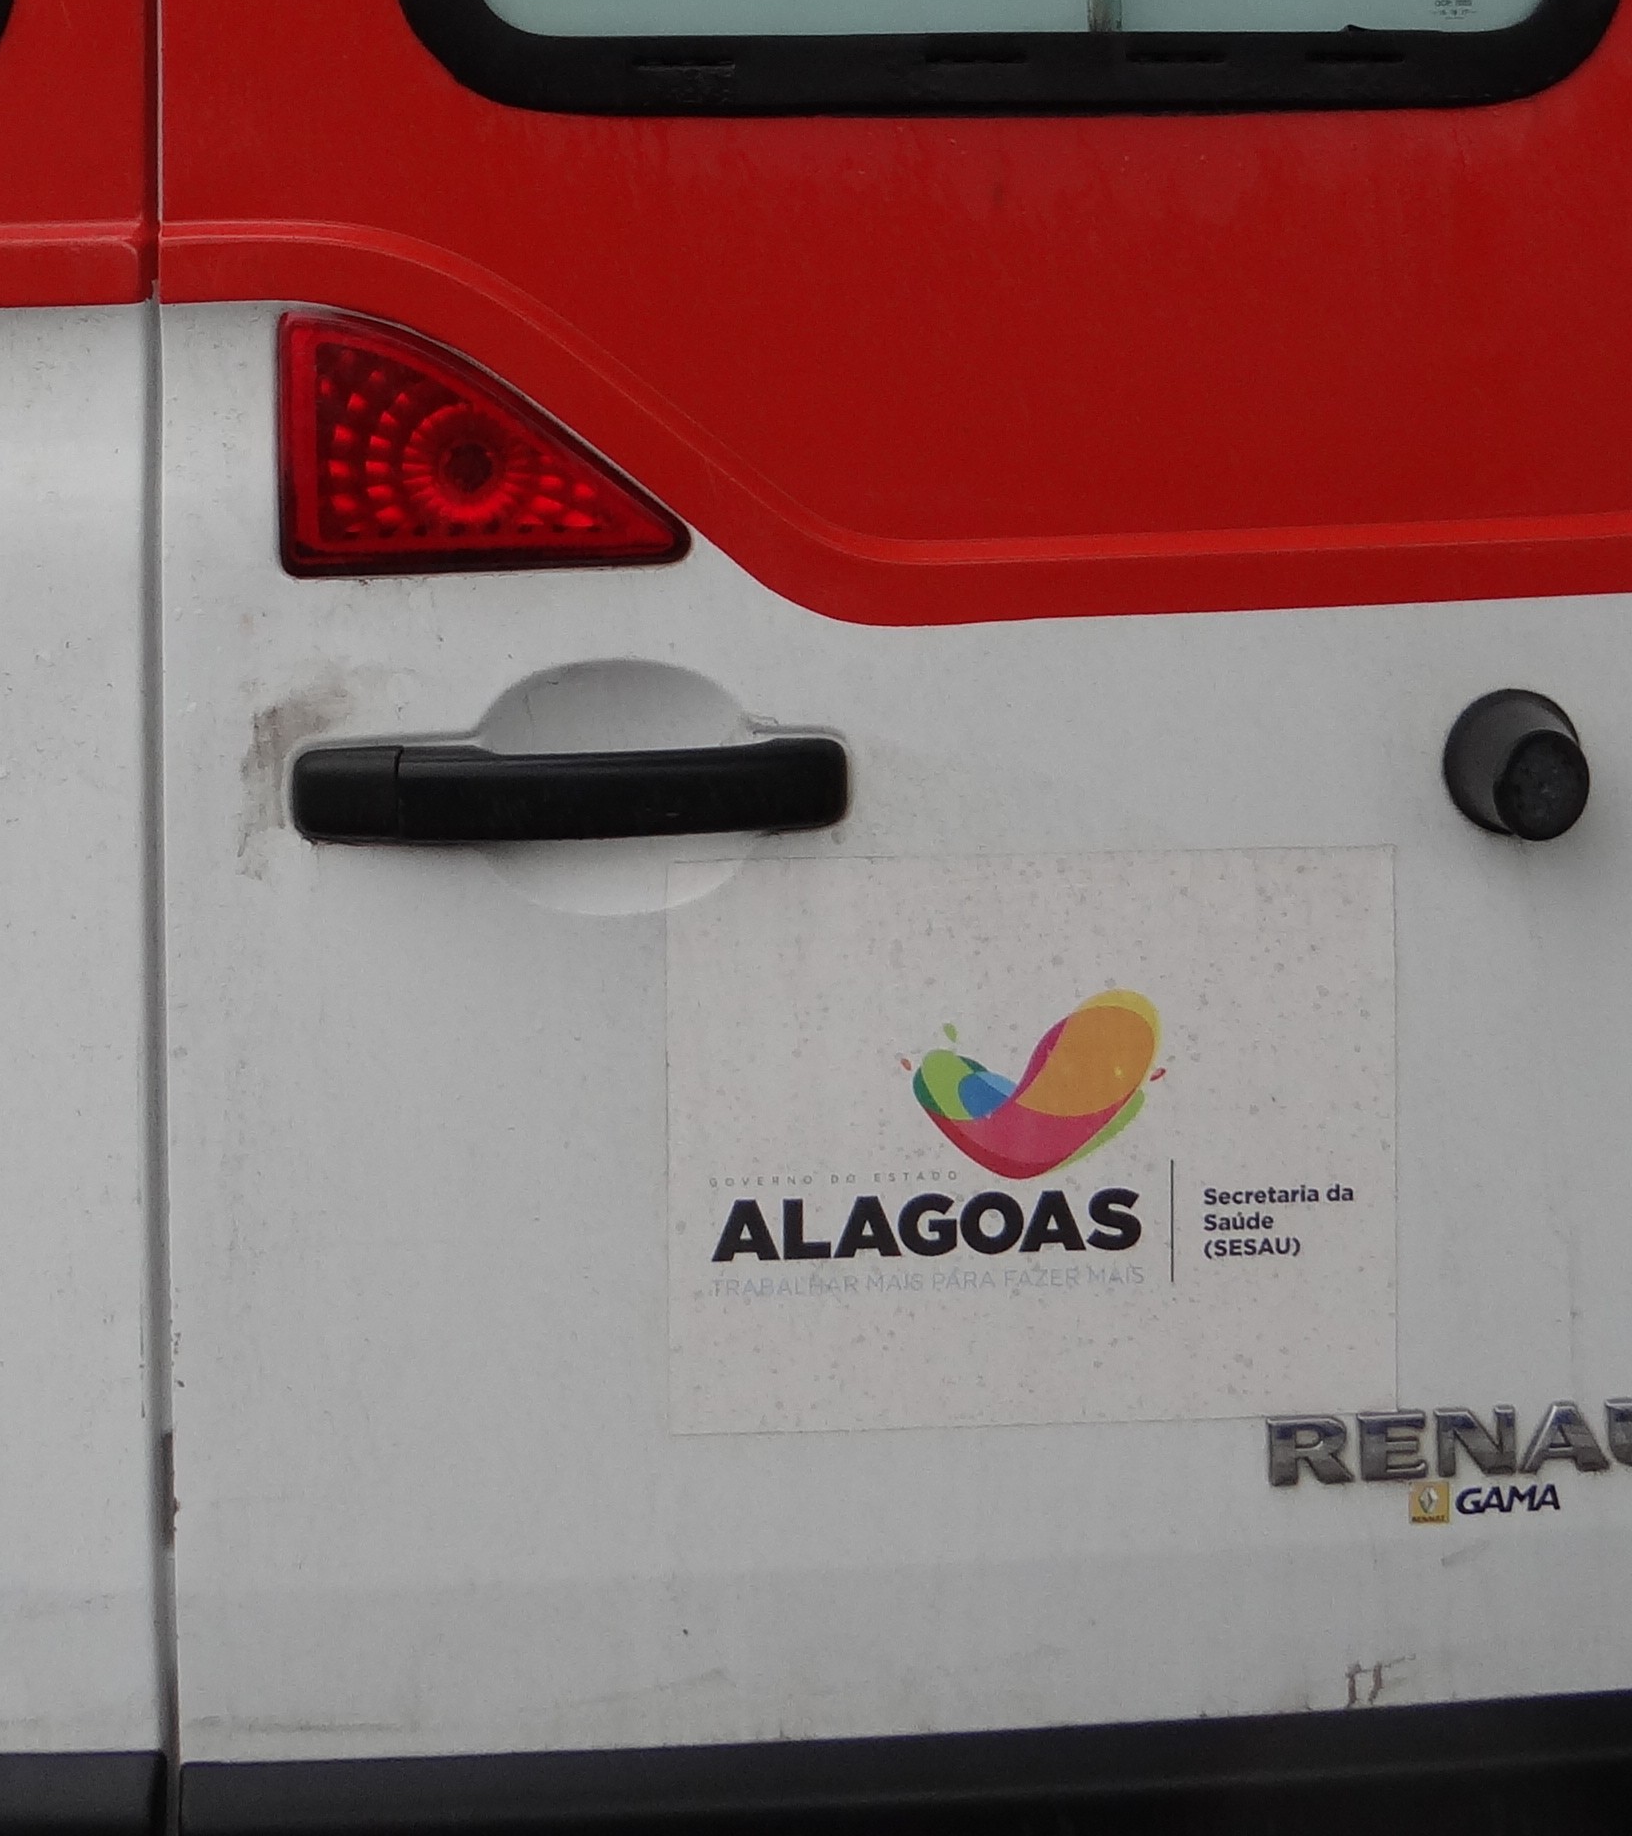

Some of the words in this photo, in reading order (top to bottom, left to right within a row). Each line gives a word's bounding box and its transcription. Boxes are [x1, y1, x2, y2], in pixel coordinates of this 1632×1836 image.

[873, 1170, 959, 1183] ESTADO
[1203, 1184, 1320, 1205] Secretaria
[1326, 1184, 1355, 1202] da
[711, 1186, 1143, 1263] ALAGOAS
[1203, 1211, 1275, 1231] Saúde
[1203, 1236, 1302, 1259] (SESAU)
[1003, 1267, 1082, 1289] FAZER
[1454, 1483, 1561, 1516] GAMA
